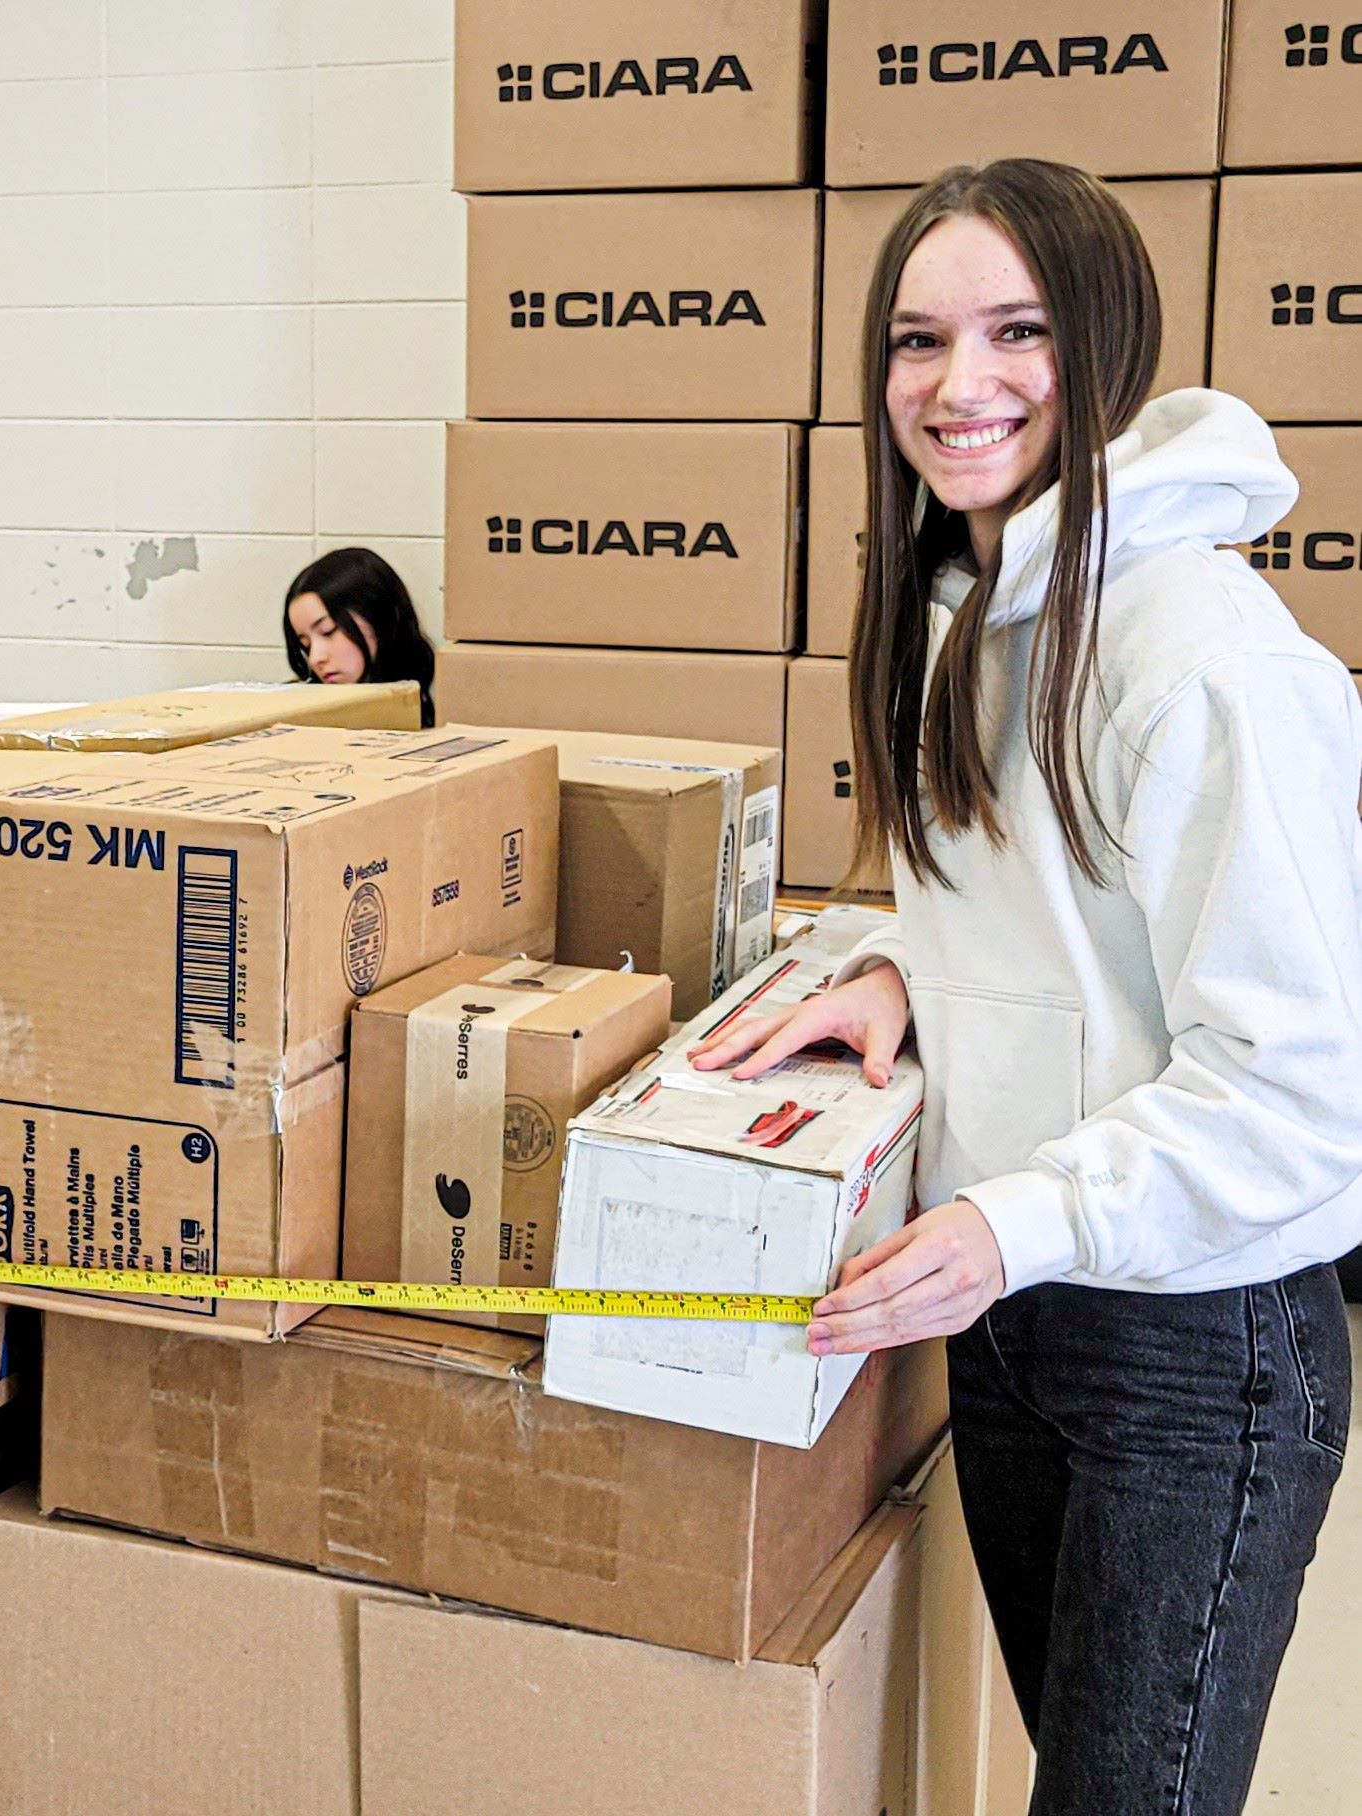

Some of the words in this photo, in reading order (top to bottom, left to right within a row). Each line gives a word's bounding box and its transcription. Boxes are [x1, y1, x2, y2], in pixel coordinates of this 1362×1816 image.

[542, 55, 754, 100] CIARA
[929, 33, 1170, 81] CIARA
[554, 290, 766, 327] CIARA
[531, 521, 739, 560] CIARA
[85, 824, 166, 871] MK
[456, 1015, 476, 1080] Serres
[22, 1119, 36, 1164] Towel
[189, 1137, 203, 1158] H2
[23, 1168, 36, 1207] Hand
[66, 1147, 80, 1191] Mains
[83, 1173, 97, 1242] Multiples
[111, 1175, 124, 1219] Mano
[111, 1221, 123, 1241] de
[127, 1207, 144, 1270] Plegado
[111, 1244, 124, 1271] alla
[450, 1225, 466, 1286] DeSerr
